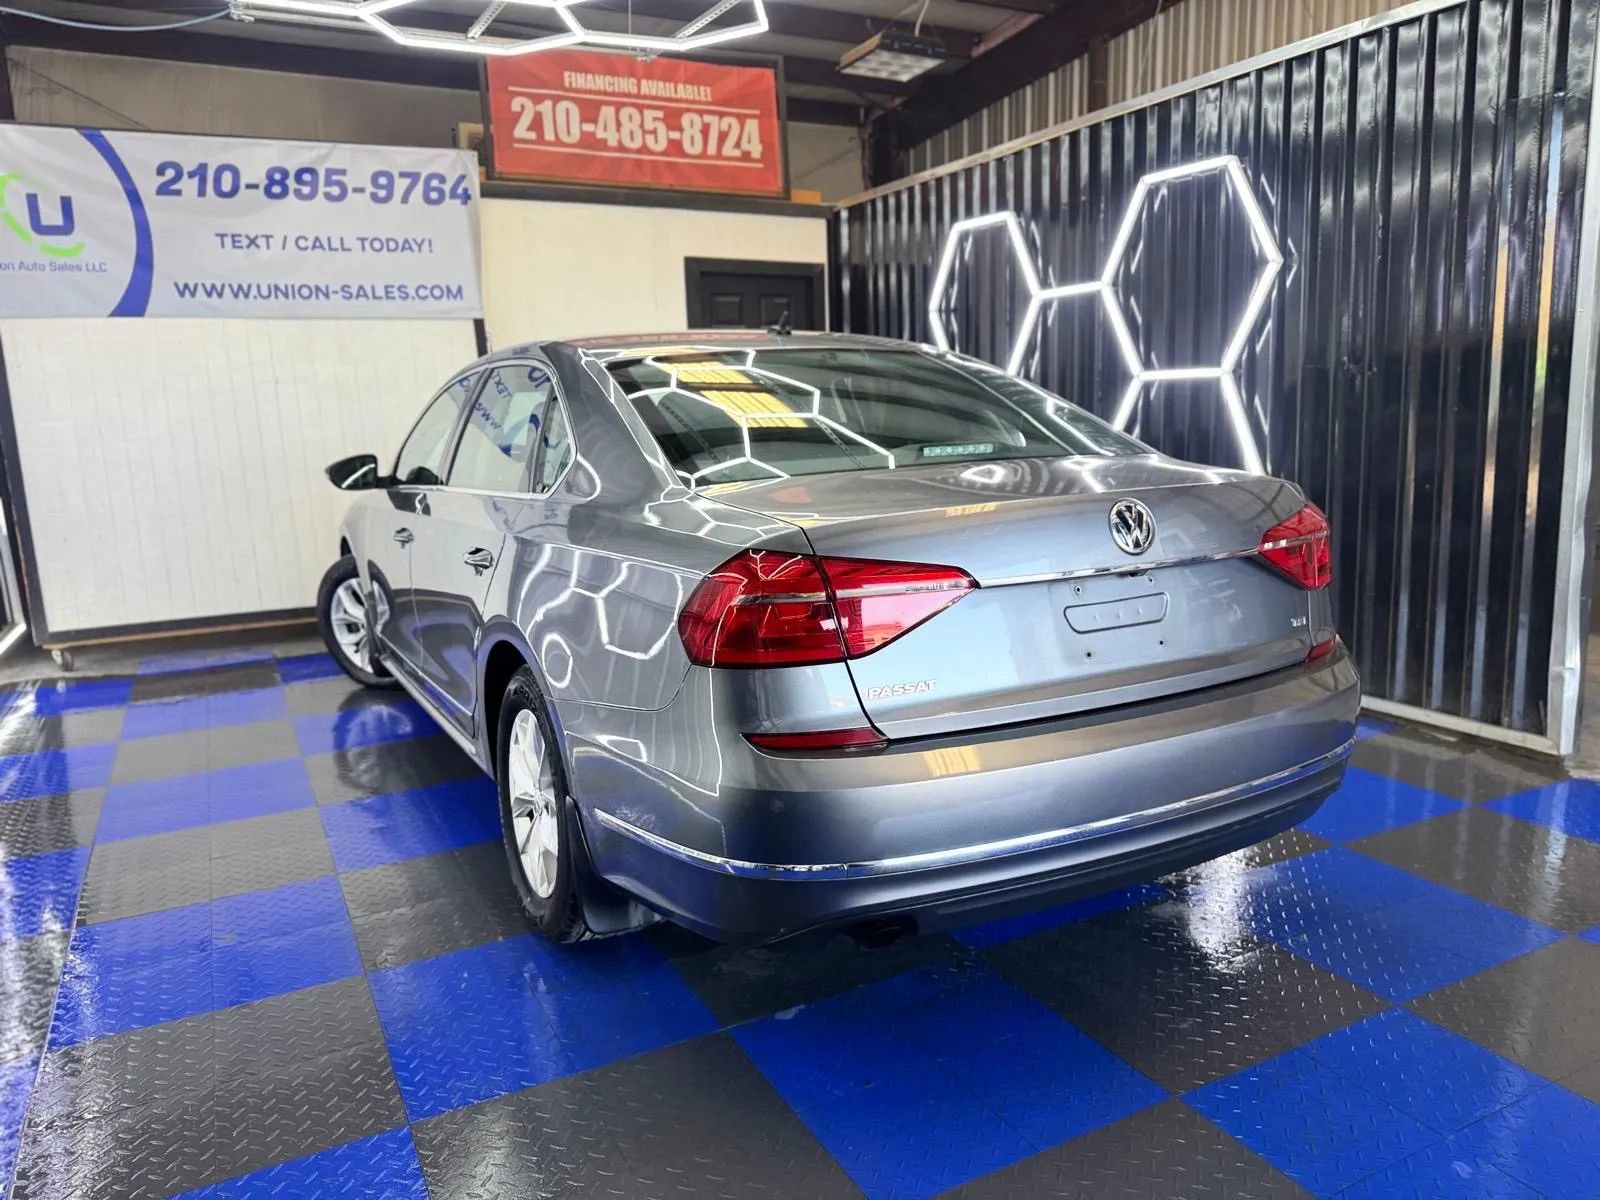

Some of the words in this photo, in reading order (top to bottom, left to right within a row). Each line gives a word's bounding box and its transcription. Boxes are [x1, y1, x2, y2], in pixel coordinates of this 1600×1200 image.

[563, 71, 639, 95] FINANCING
[640, 79, 713, 101] AVAILABLE!
[510, 96, 763, 159] 210-485-8724
[155, 161, 473, 206] 210-895-9764
[215, 232, 275, 250] TEXT
[294, 235, 353, 252] CALL
[356, 236, 434, 254] TODAY!
[18, 261, 47, 273] Auto
[49, 261, 83, 273] Sales
[85, 262, 108, 273] LLC
[174, 281, 464, 302] WWW.UNION-SALES.COM
[866, 679, 938, 701] PASSAT
